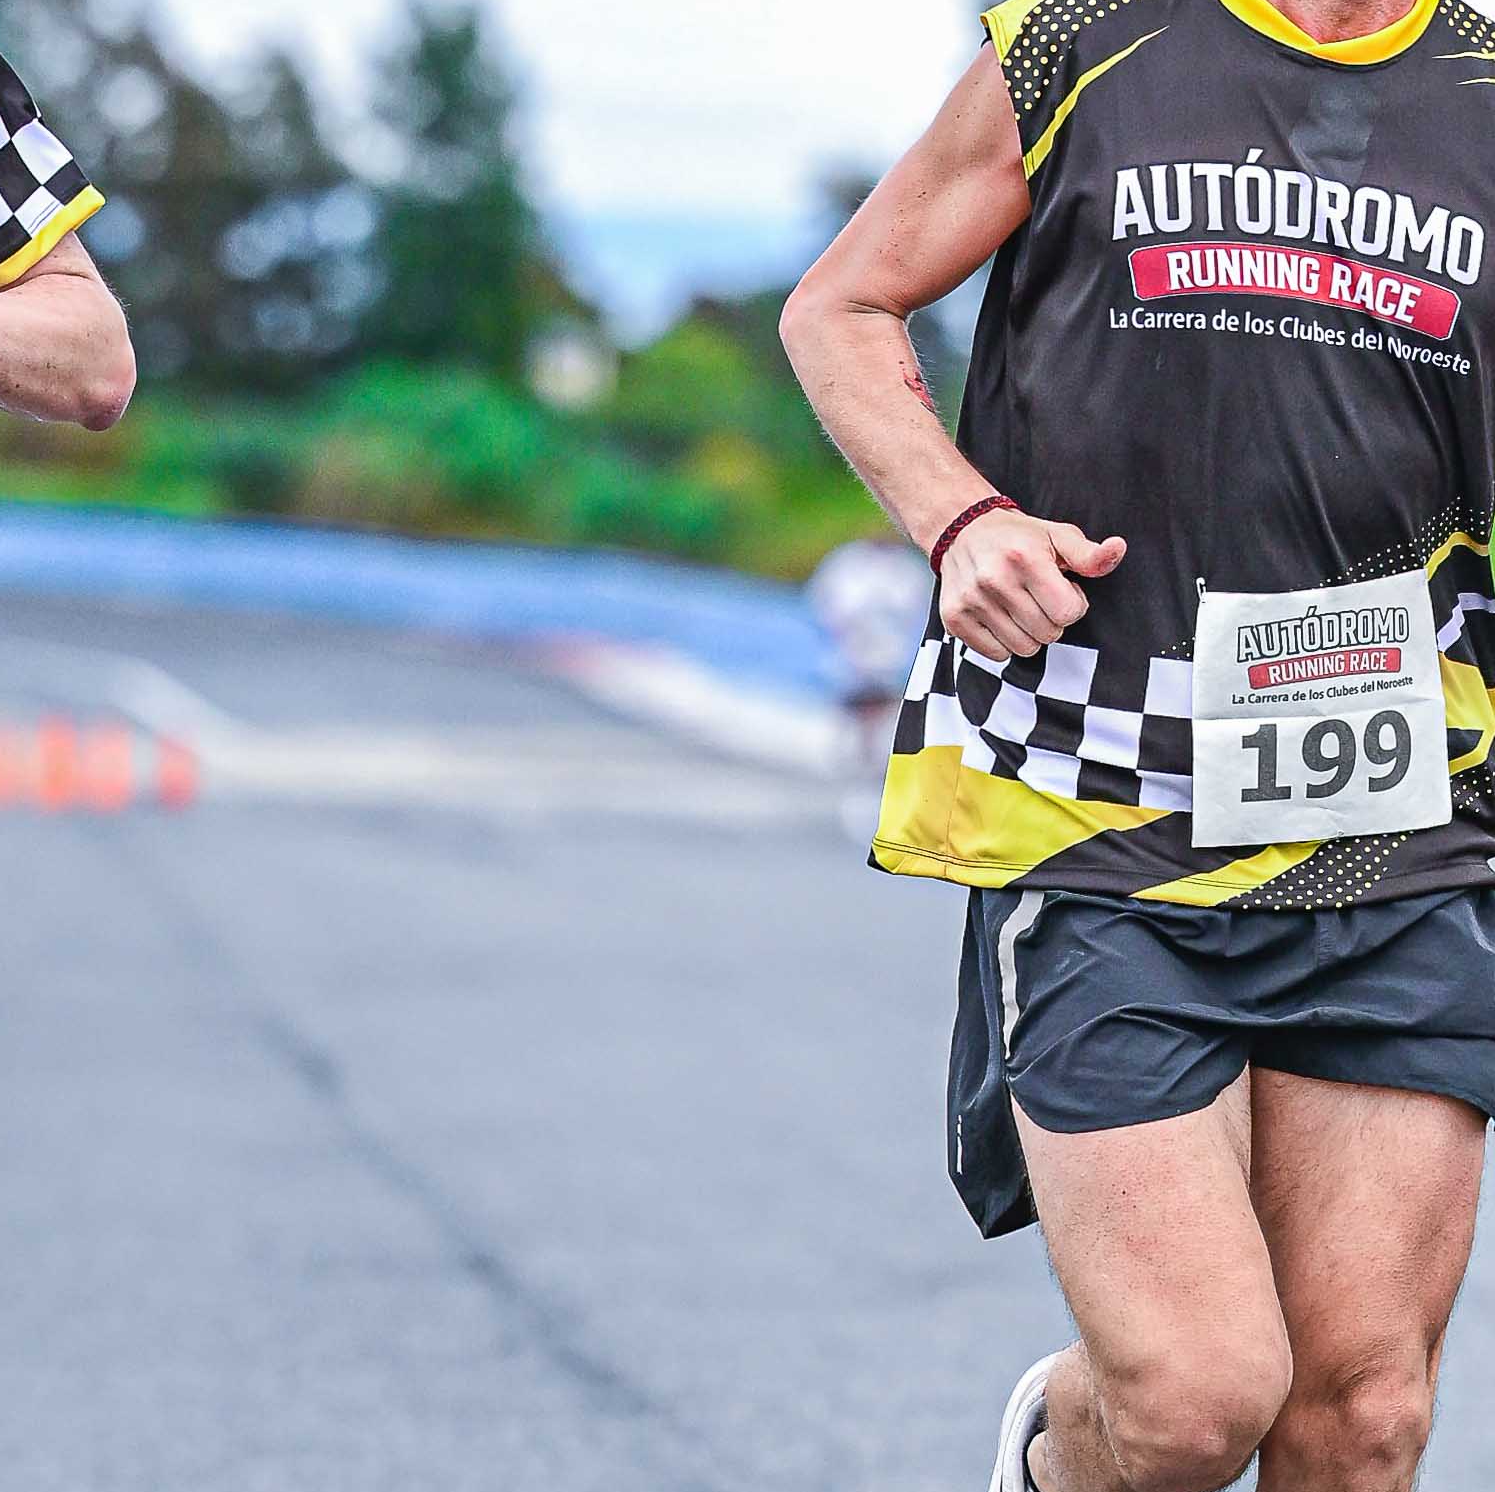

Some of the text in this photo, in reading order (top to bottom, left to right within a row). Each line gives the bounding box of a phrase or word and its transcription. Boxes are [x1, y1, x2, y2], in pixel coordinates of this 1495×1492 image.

[1112, 148, 1485, 285] AUTÓDROMO
[1165, 248, 1423, 325] RUNNING RACE
[1109, 307, 1472, 376] La Carrera de los Clubes del Noroeste
[1237, 606, 1410, 663] AUTÓDROMO
[1267, 651, 1388, 685] RUNNING RACE
[1231, 675, 1414, 705] La Carrera de los Clubes del Noroeste
[1241, 709, 1412, 803] 199
